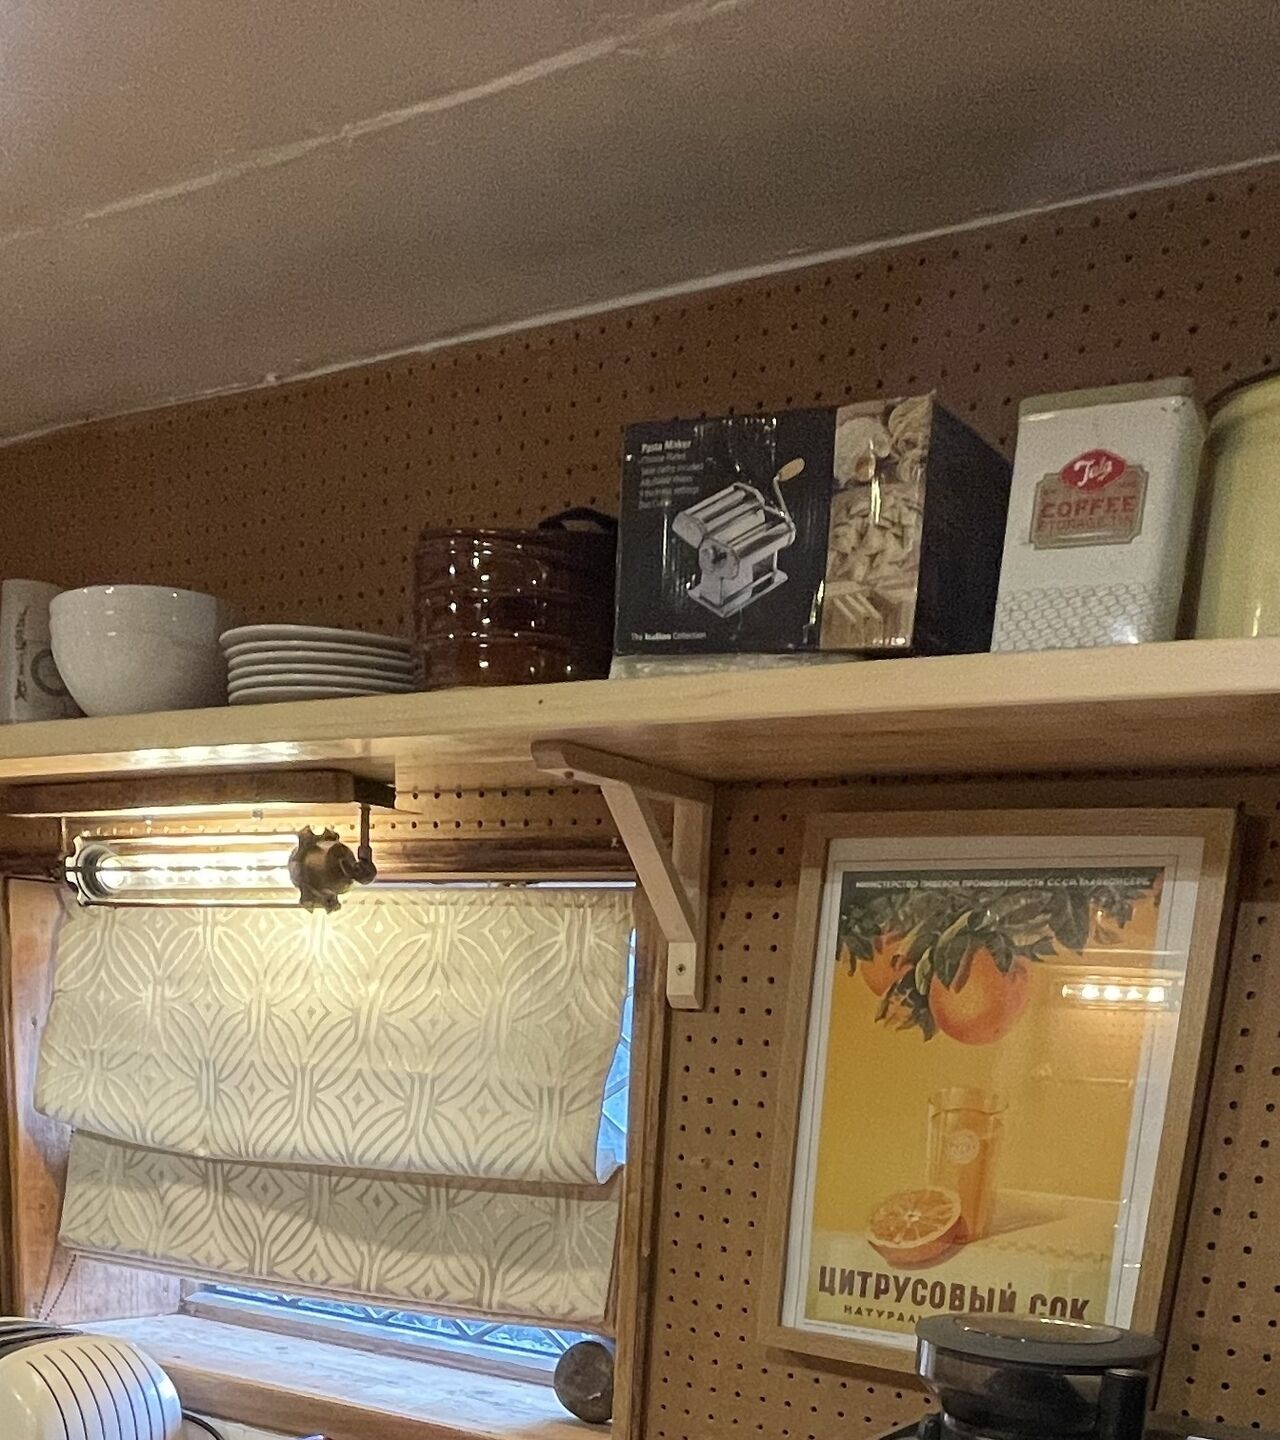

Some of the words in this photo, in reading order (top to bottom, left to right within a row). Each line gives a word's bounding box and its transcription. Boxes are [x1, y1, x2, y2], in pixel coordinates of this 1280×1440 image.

[1040, 495, 1136, 518] COFFEE
[818, 1265, 1017, 1313] ЦИТРУСОВЫЙ
[1028, 1292, 1090, 1321] СОК
[843, 1304, 922, 1324] НАТУРАЛ
